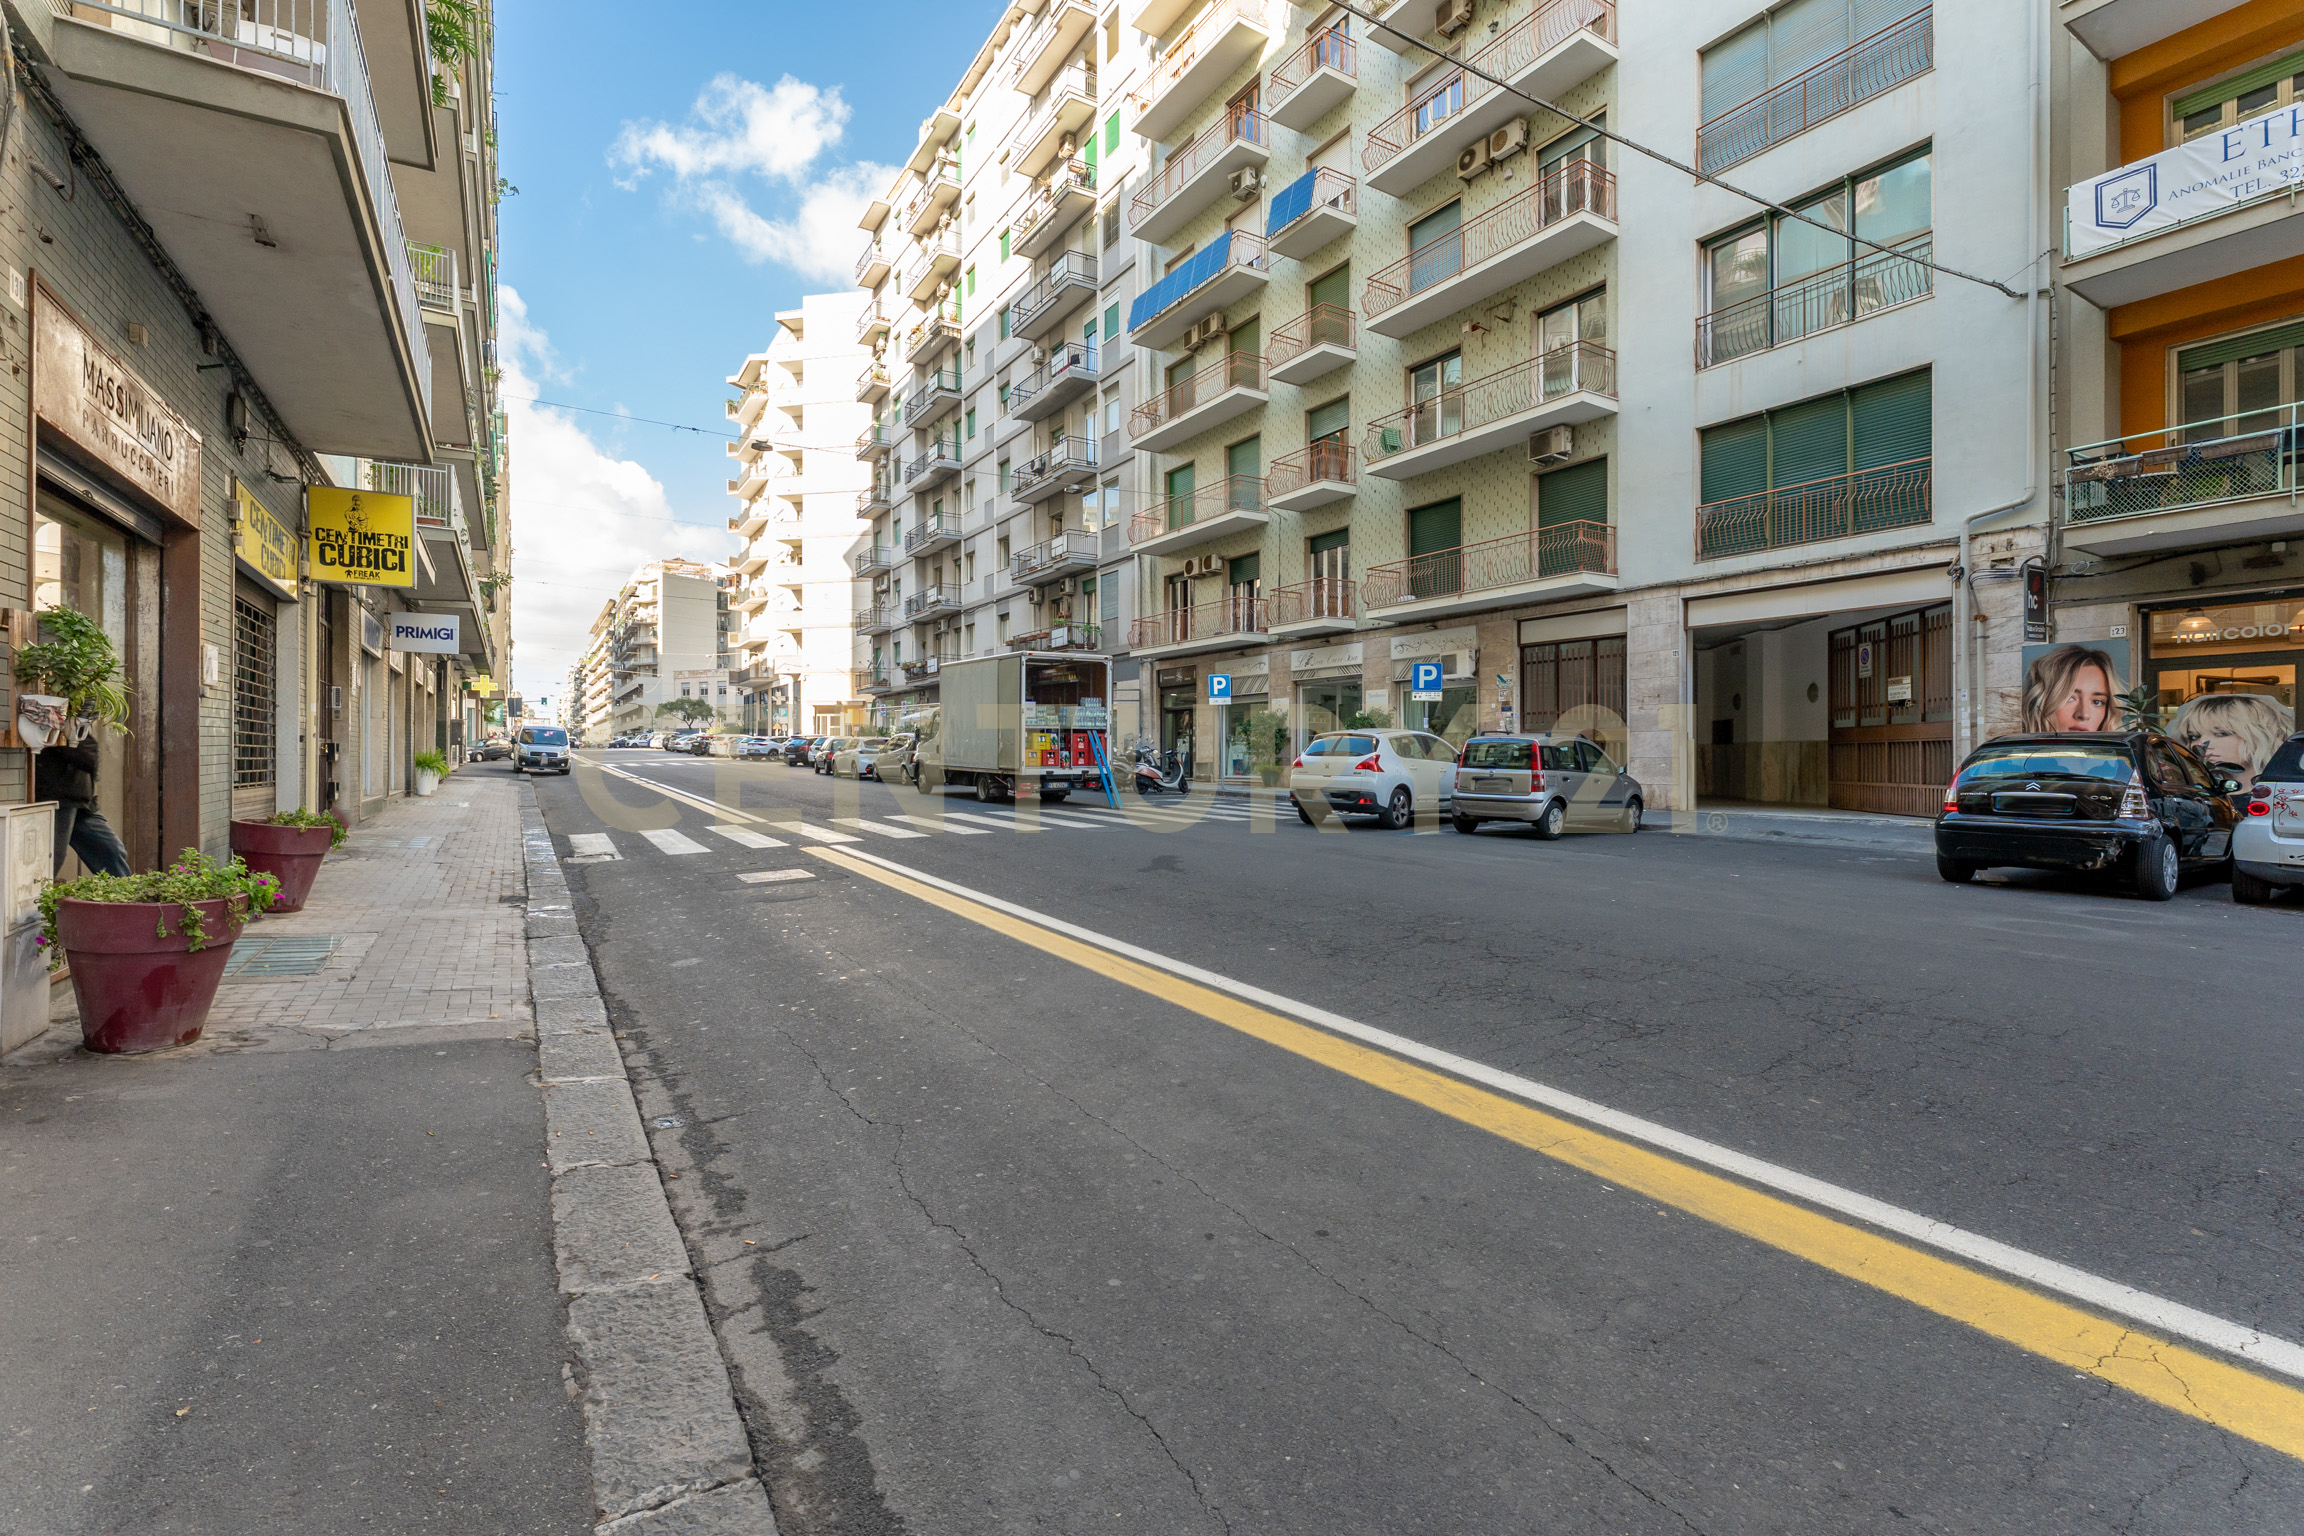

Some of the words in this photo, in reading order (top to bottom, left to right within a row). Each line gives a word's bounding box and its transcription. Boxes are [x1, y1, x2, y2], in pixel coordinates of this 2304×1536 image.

[2168, 165, 2251, 201] ANOMALIE
[2229, 178, 2272, 198] TEL.
[2279, 165, 2304, 184] 32
[82, 351, 173, 462] MASSIMILIANO
[82, 409, 174, 497] PARRUCCHIERI
[250, 499, 296, 566] CENTIMETRI
[315, 527, 409, 549] CENTIMETRI
[260, 542, 287, 580] CUBICI
[318, 543, 406, 572] CUBICI
[353, 569, 381, 579] FREAK
[2027, 590, 2039, 609] hc
[395, 625, 454, 641] PRIMIGI
[2176, 622, 2292, 644] haircolor
[1213, 677, 1227, 695] P
[1419, 665, 1438, 688] P
